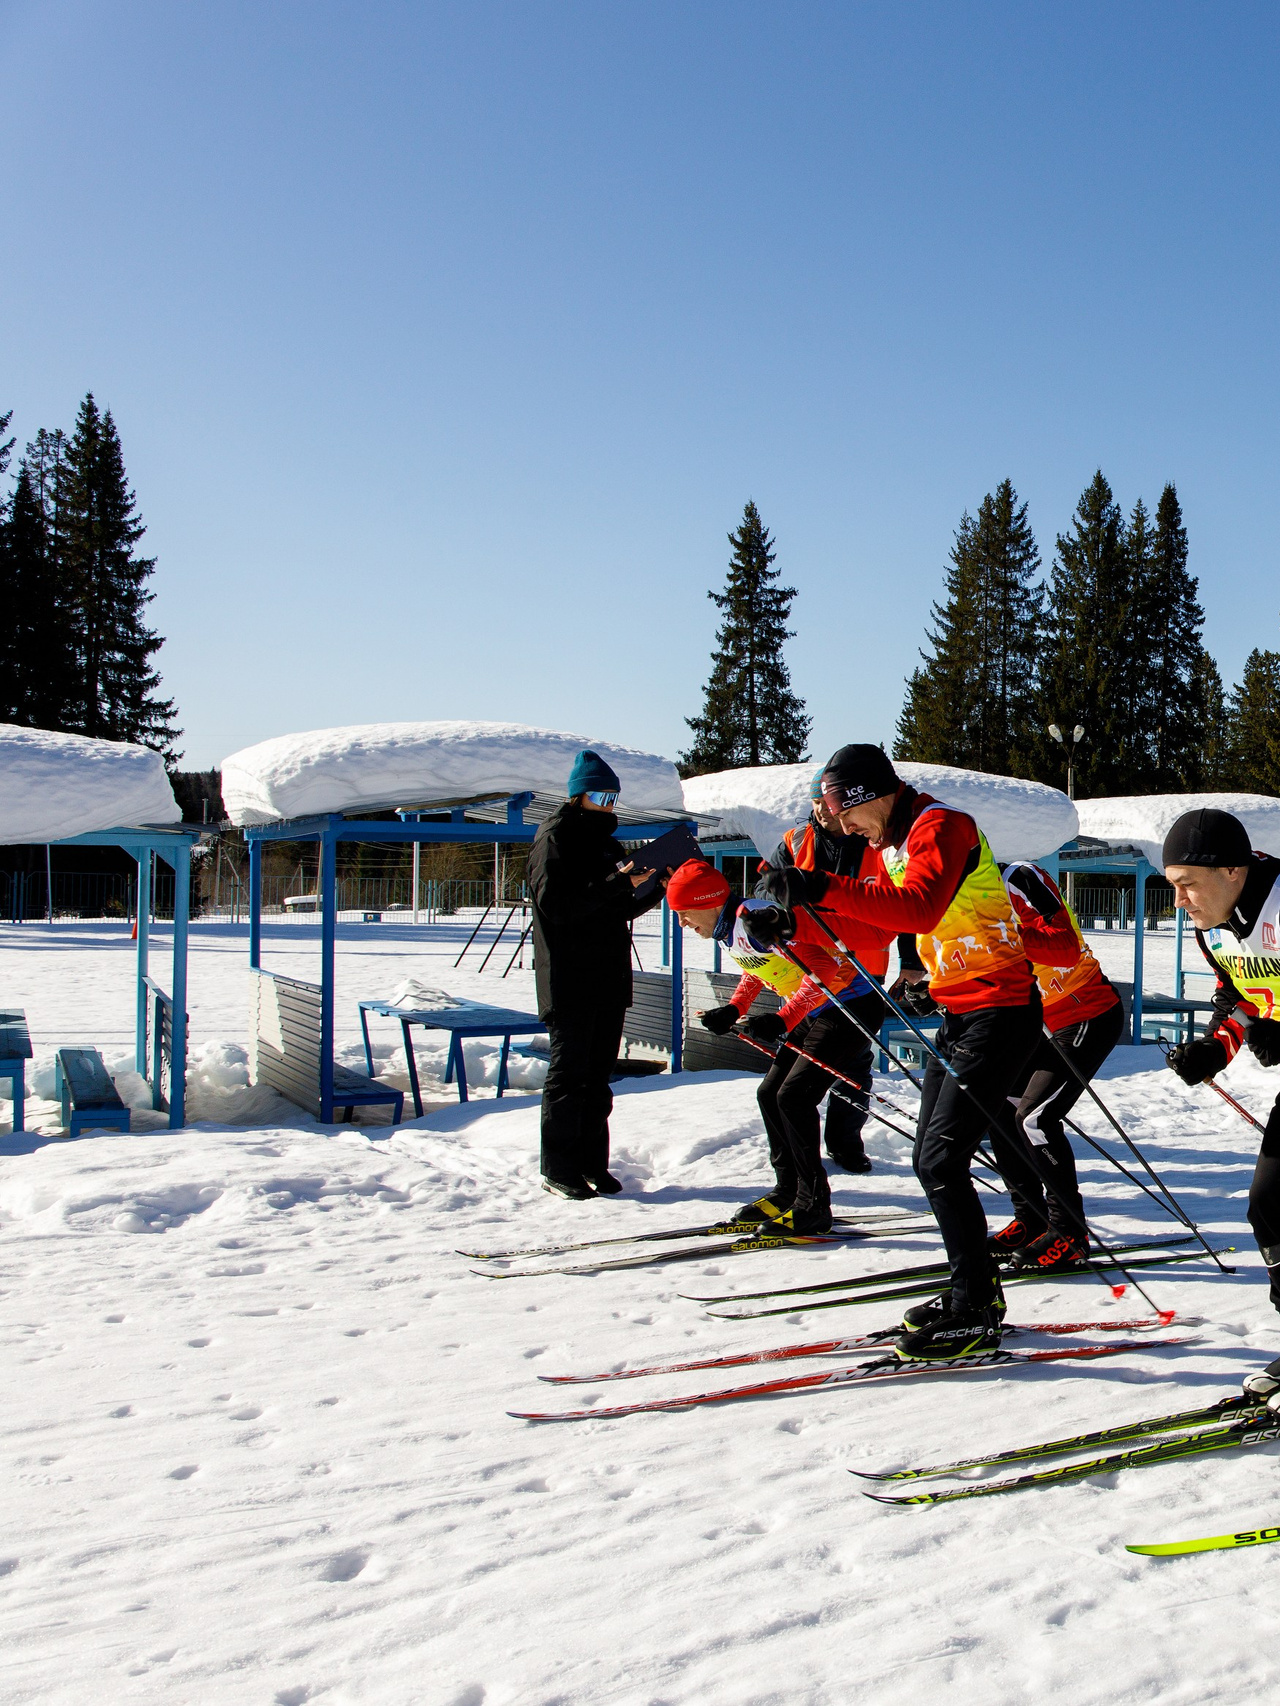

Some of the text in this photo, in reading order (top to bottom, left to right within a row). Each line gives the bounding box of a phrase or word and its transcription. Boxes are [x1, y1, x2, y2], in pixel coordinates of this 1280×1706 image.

[846, 785, 865, 798] ice
[842, 792, 876, 808] odlo
[951, 949, 966, 970] 1
[1050, 977, 1064, 994] 1
[1219, 1406, 1268, 1422] FISC
